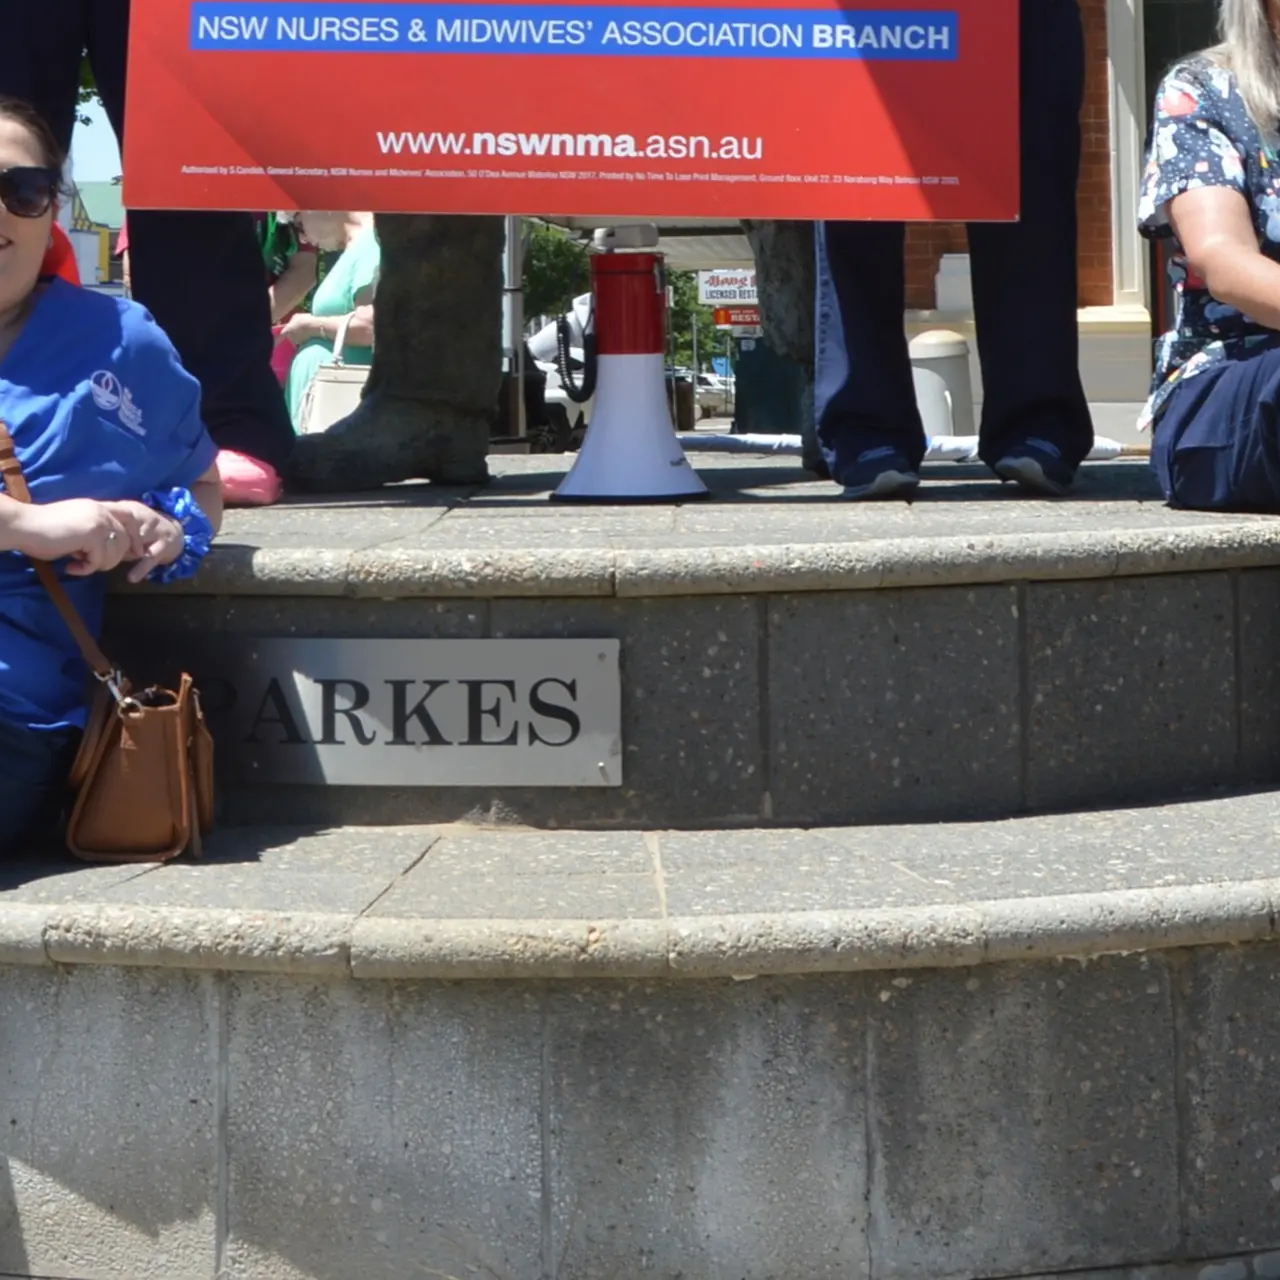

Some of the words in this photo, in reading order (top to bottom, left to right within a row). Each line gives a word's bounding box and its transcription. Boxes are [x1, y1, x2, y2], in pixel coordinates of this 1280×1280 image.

[197, 16, 269, 41] NSW
[276, 17, 400, 42] NURSES
[407, 18, 428, 43] &
[436, 19, 594, 45] MIDWIVES'
[601, 21, 803, 48] ASSOCIATION
[811, 25, 950, 50] BRANCH
[377, 130, 763, 160] www.nswnma.asn.au
[739, 289, 757, 299] REST
